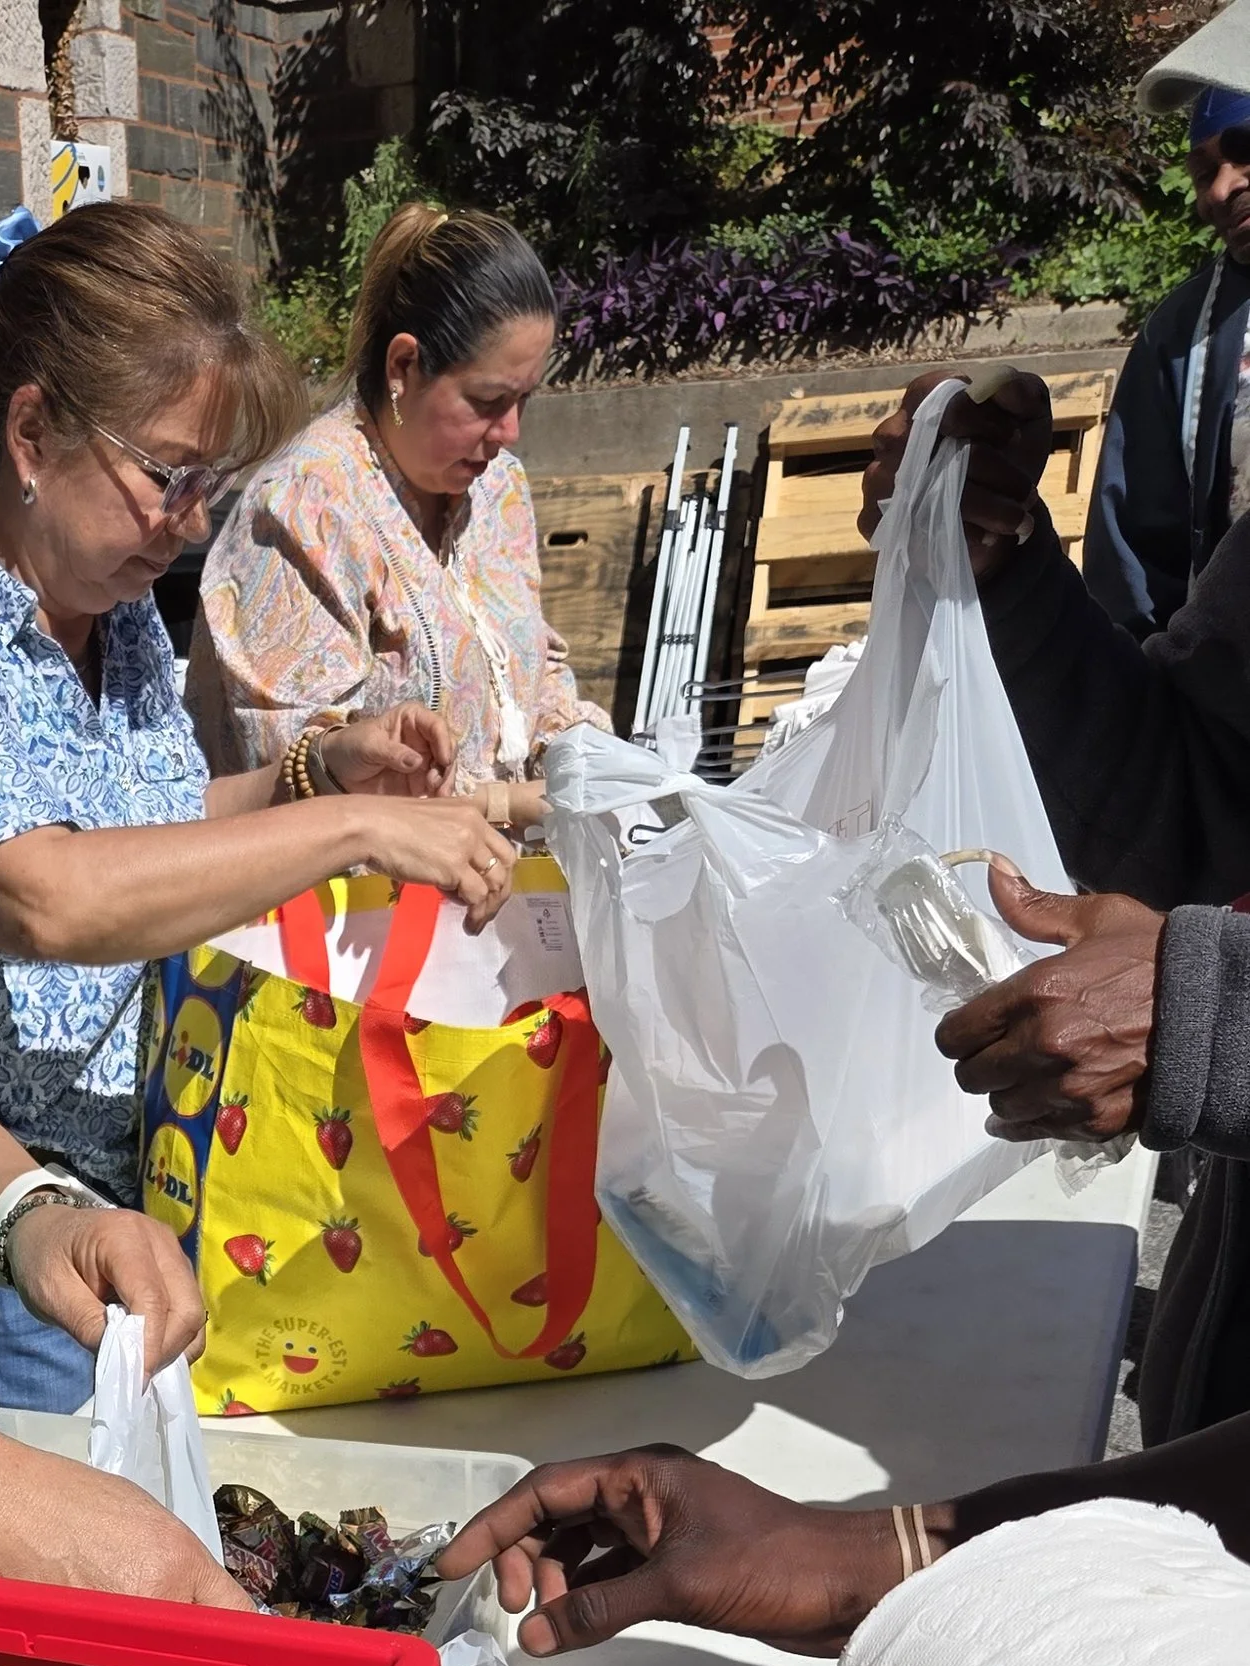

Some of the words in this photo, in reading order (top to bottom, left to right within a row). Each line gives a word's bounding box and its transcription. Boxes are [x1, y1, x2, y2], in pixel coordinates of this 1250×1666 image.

[255, 1328, 276, 1359] THE
[273, 1317, 348, 1368] SUPER-EST
[263, 1371, 335, 1395] MARKET
